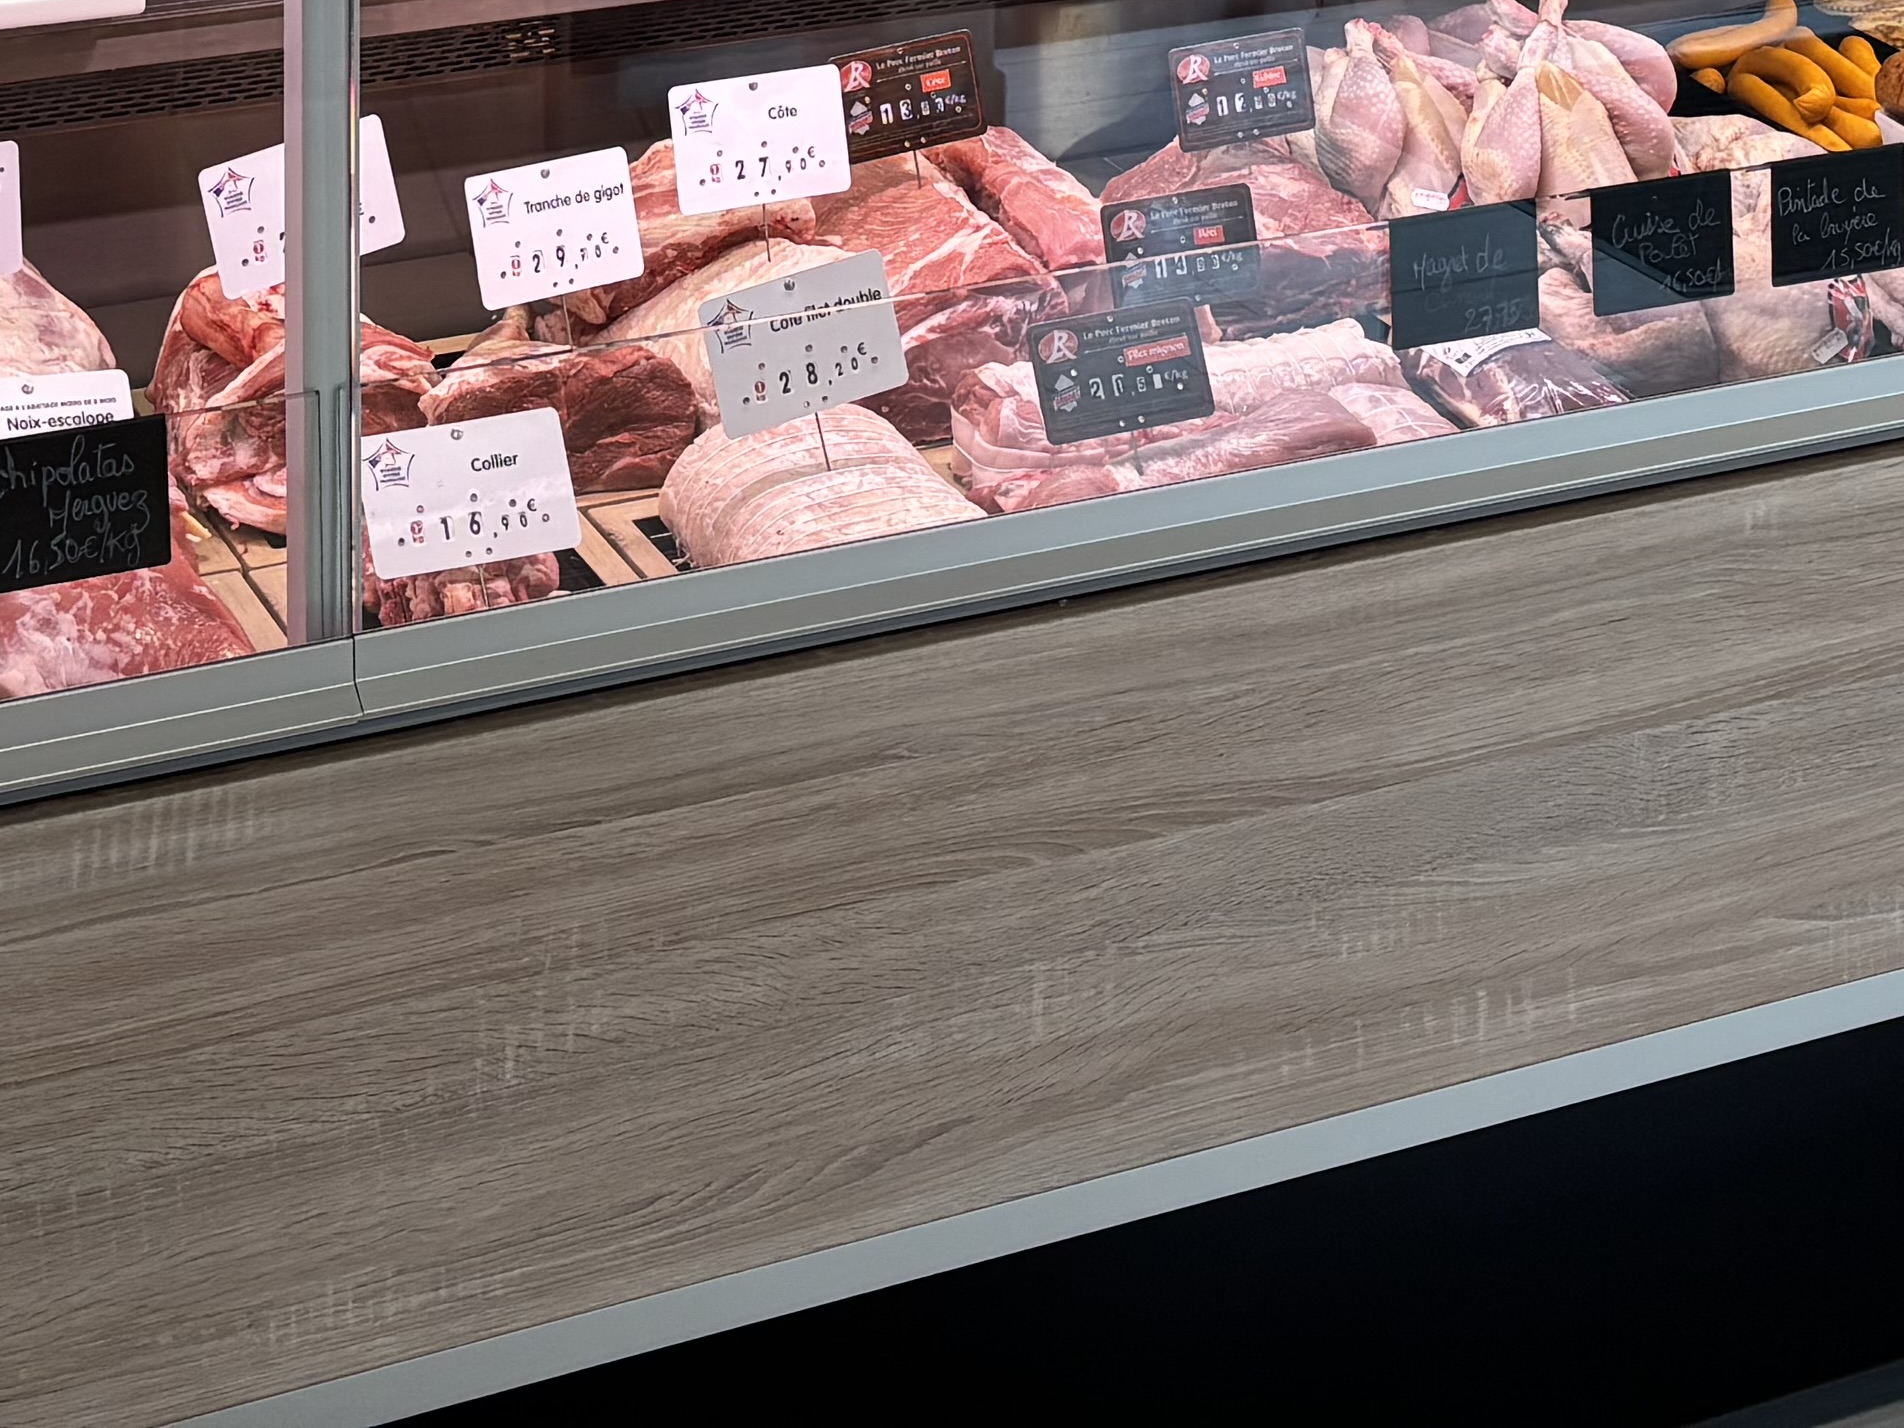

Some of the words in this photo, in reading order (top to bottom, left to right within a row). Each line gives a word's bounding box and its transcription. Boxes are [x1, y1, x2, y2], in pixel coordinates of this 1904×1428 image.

[768, 104, 798, 121] Côte
[524, 195, 572, 215] Tranche
[575, 191, 590, 207] de
[593, 182, 624, 205] gigot
[1854, 177, 1886, 203] de
[1689, 199, 1721, 230] de
[7, 411, 114, 431] Noix-escalope
[471, 452, 519, 472] Collier
